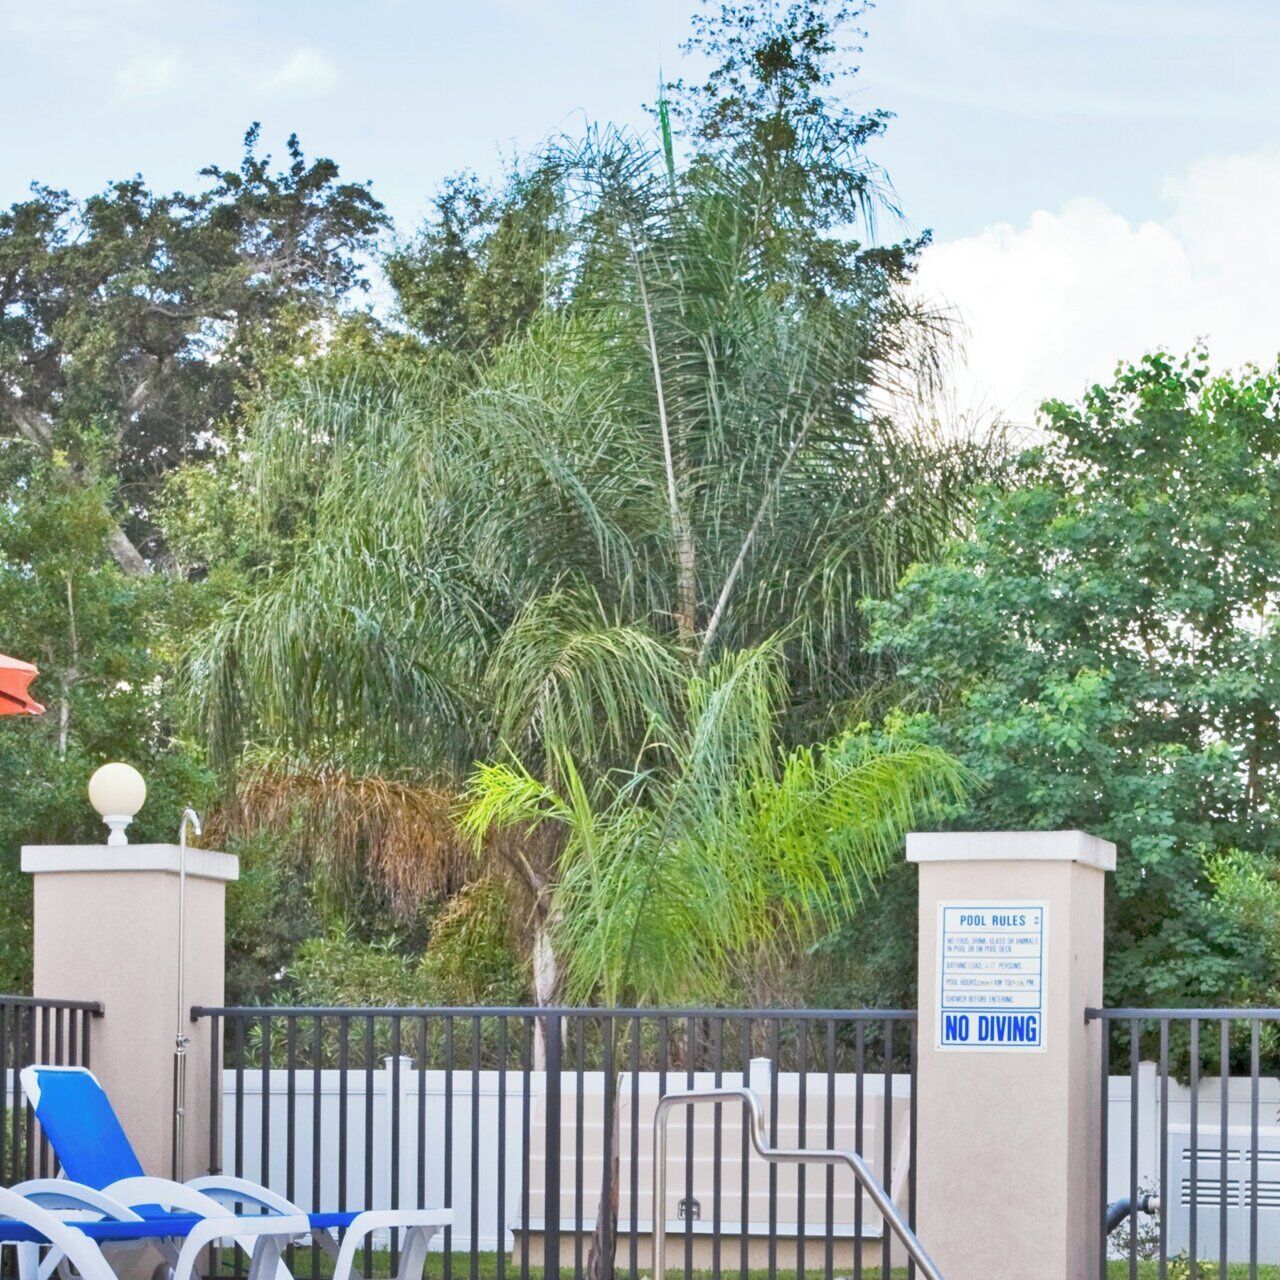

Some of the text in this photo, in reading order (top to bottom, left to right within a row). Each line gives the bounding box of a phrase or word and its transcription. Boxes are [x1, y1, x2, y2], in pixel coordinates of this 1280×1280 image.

[960, 915, 986, 926] POOL
[992, 915, 1026, 926] RULES
[946, 1015, 1037, 1042] NO DIVING
